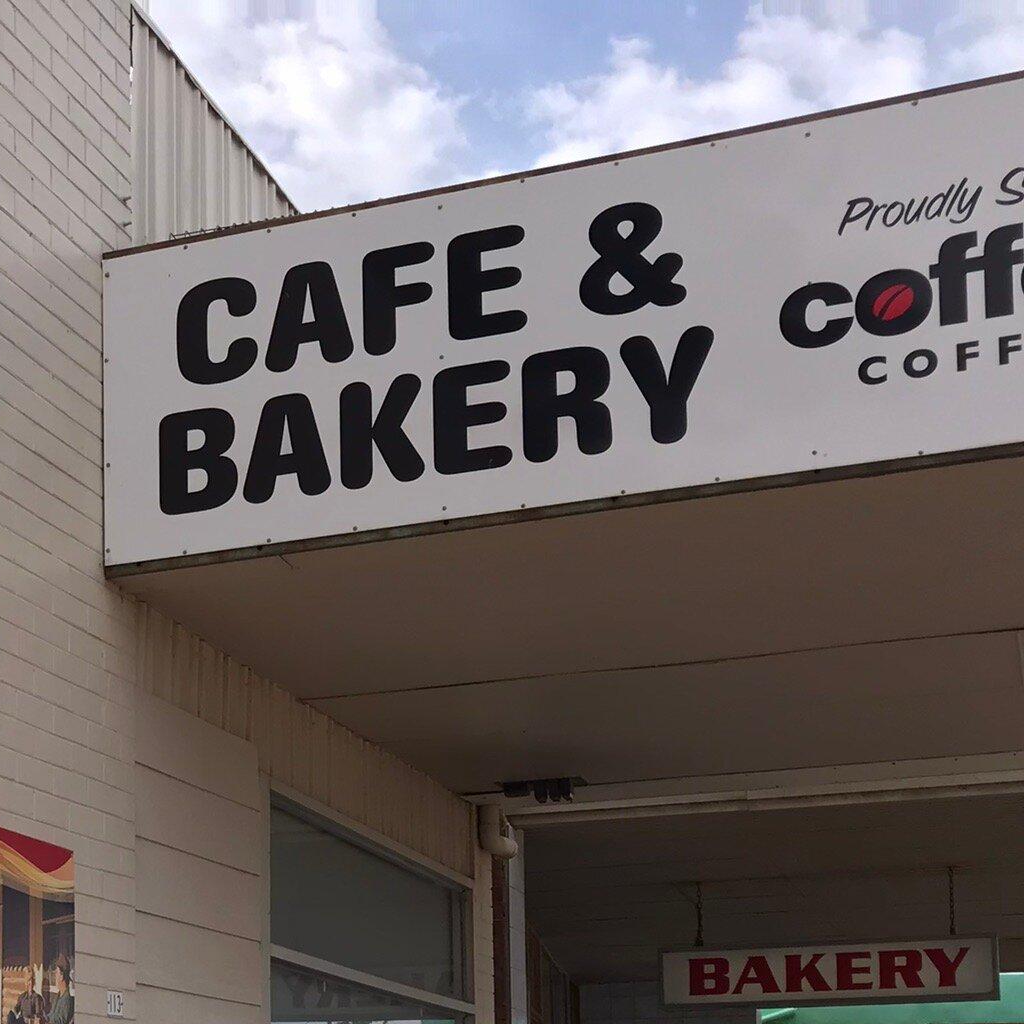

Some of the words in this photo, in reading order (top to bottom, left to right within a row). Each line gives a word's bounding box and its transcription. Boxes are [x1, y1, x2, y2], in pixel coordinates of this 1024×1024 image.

[837, 177, 984, 236] Proudly
[175, 224, 528, 386] CAFE
[578, 201, 687, 316] &
[779, 222, 1024, 349] coff
[157, 325, 715, 516] BAKERY
[688, 947, 971, 997] BAKERY
